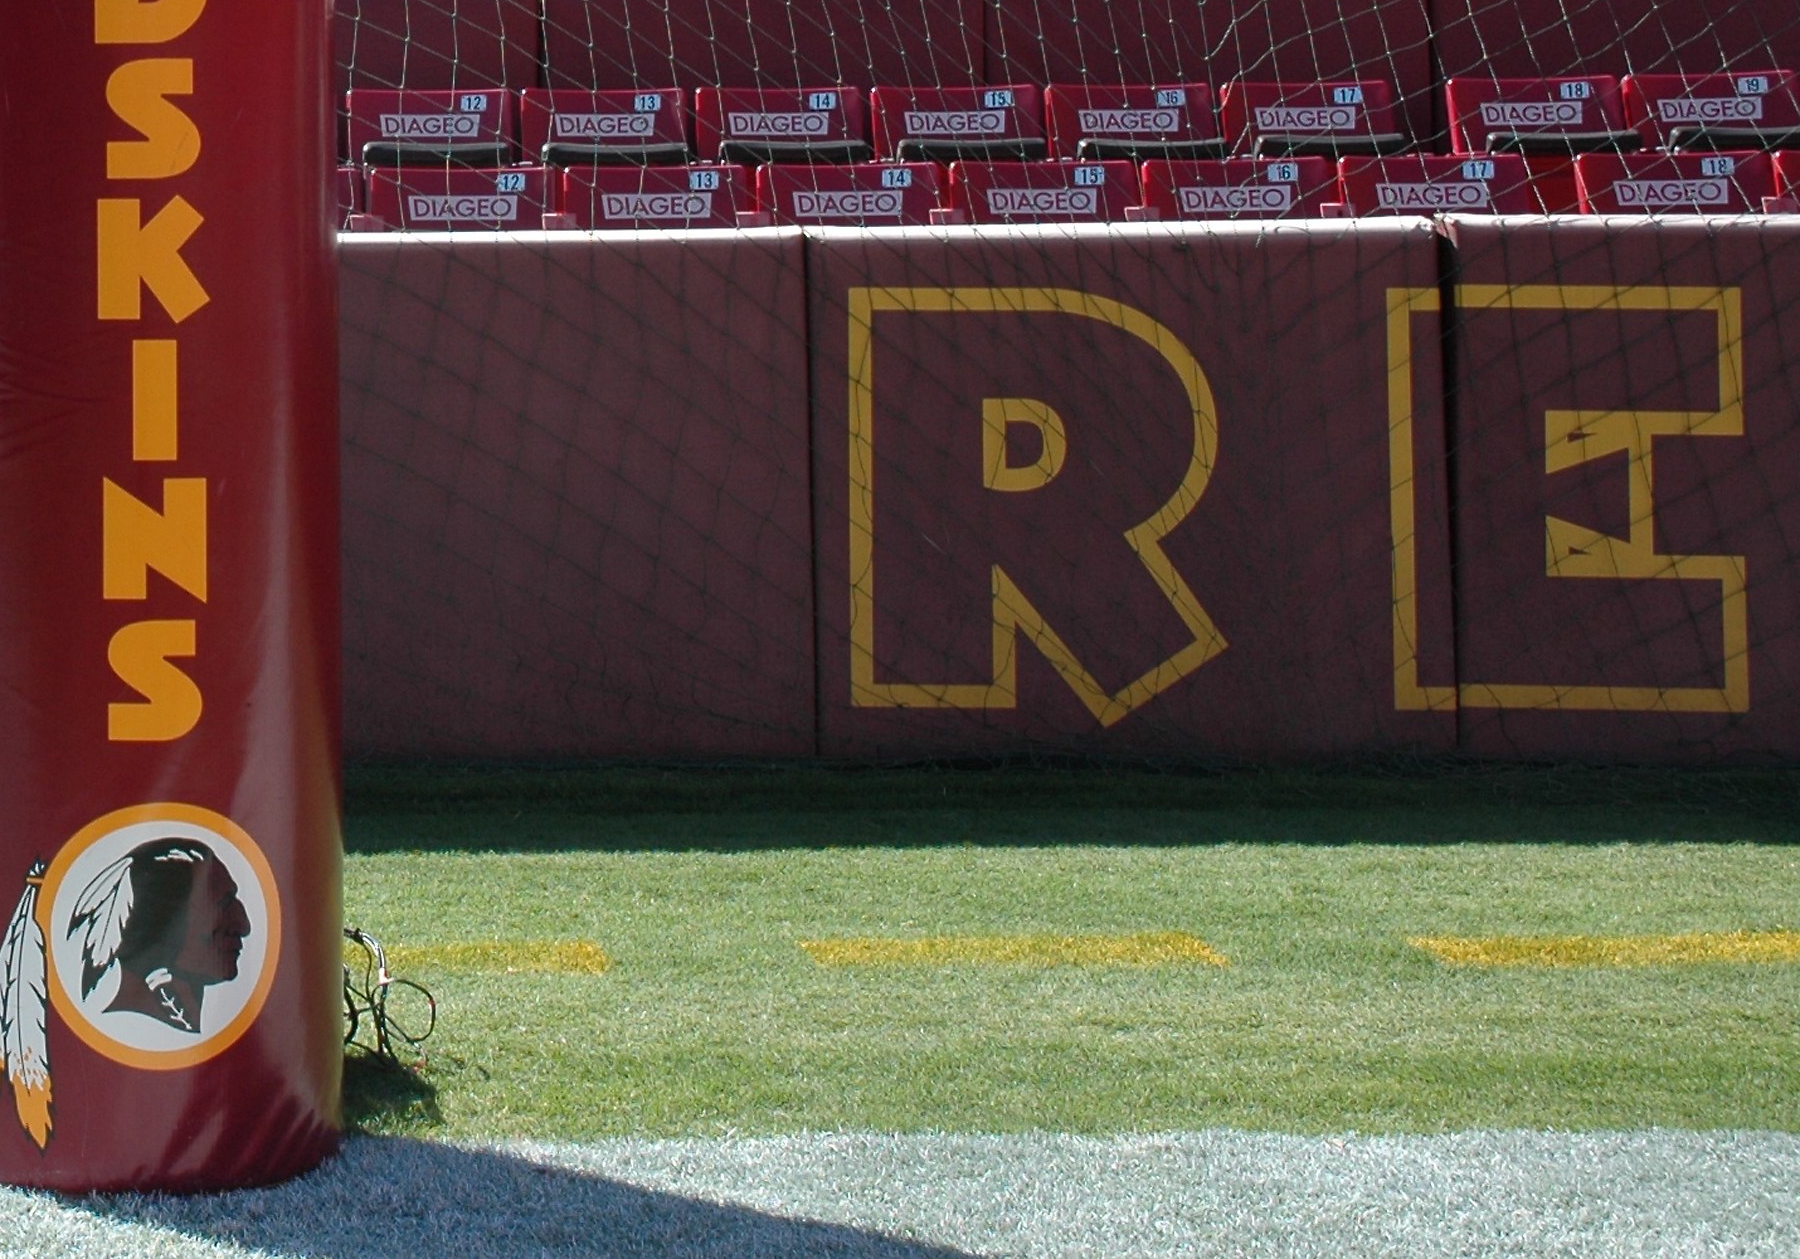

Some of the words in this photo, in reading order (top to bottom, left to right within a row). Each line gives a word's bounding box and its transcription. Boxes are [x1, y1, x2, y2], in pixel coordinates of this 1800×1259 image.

[1339, 86, 1356, 103] 17
[1566, 82, 1584, 98] 18
[465, 95, 482, 111] 12
[638, 94, 656, 111] 13
[813, 94, 831, 110] 14
[989, 92, 1006, 108] 15
[1661, 99, 1757, 118] DIAGEO
[733, 113, 825, 133] DIAGEO
[908, 113, 1001, 132] DIAGEO
[1083, 111, 1175, 130] DIAGEO
[1260, 108, 1352, 127] DIAGEO
[1484, 104, 1579, 124] DIAGEO
[384, 115, 476, 135] DIAGEO
[559, 114, 651, 134] DIAGEO
[1468, 161, 1488, 179] 17
[1708, 158, 1727, 174] 18
[502, 174, 520, 191] 12
[695, 172, 714, 189] 13
[887, 170, 906, 187] 14
[1080, 168, 1099, 184] 15
[1185, 187, 1286, 209] DIAGEO
[1381, 184, 1482, 206] DIAGEO
[1619, 181, 1722, 202] DIAGEO
[413, 197, 513, 218] DIAGEO
[607, 195, 707, 216] DIAGEO
[798, 193, 898, 215] DIAGEO
[992, 191, 1092, 212] DIAGEO
